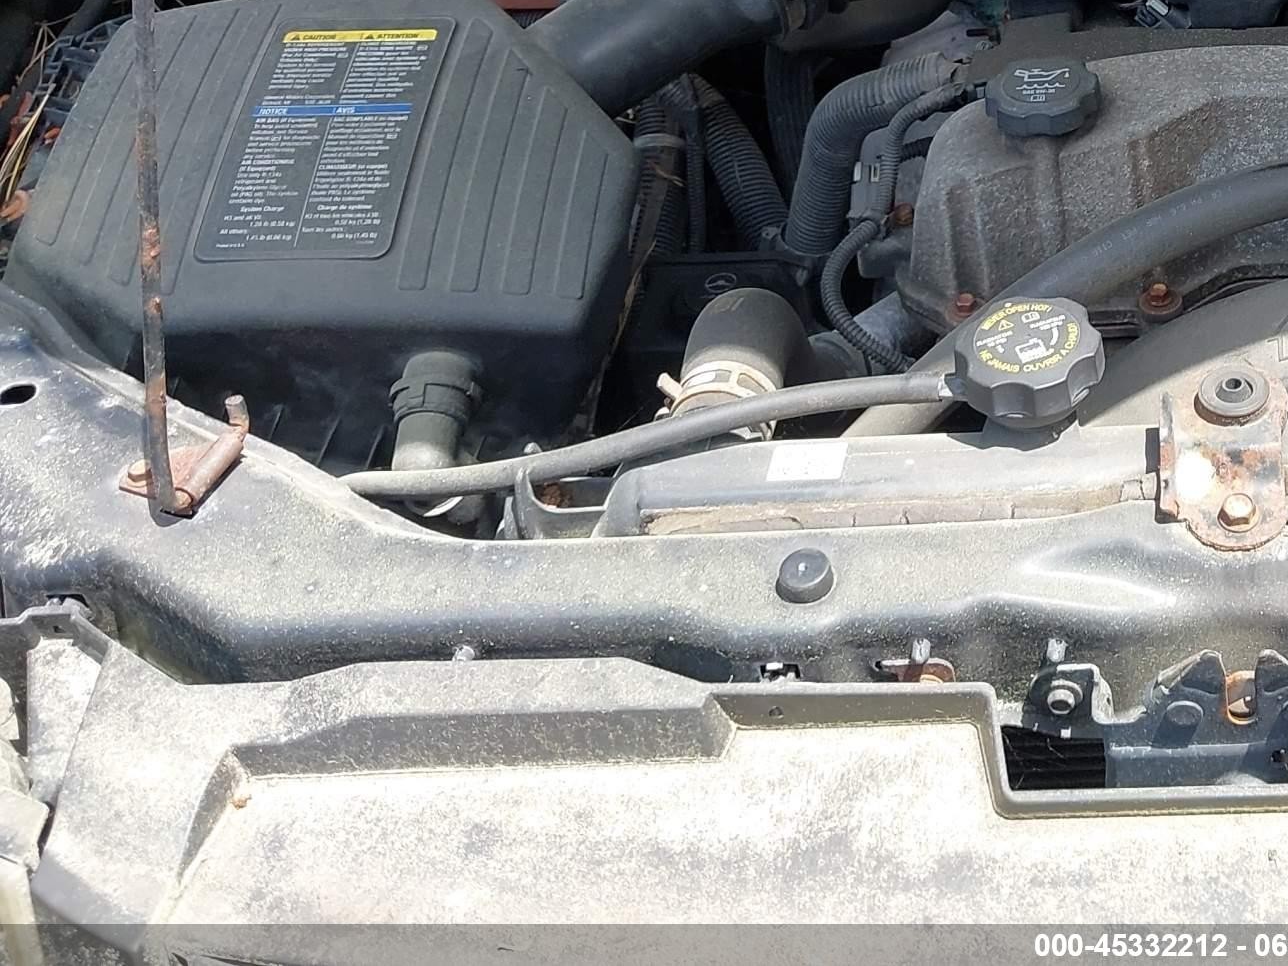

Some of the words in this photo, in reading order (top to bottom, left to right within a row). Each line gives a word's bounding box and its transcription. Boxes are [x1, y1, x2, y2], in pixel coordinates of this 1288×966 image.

[1006, 304, 1030, 314] OPEN
[1031, 304, 1053, 312] HOT!
[979, 349, 993, 362] NE
[987, 358, 1020, 372] JAMAIS
[1023, 353, 1063, 372] OUVRIR
[1064, 323, 1078, 350] CHAUD
